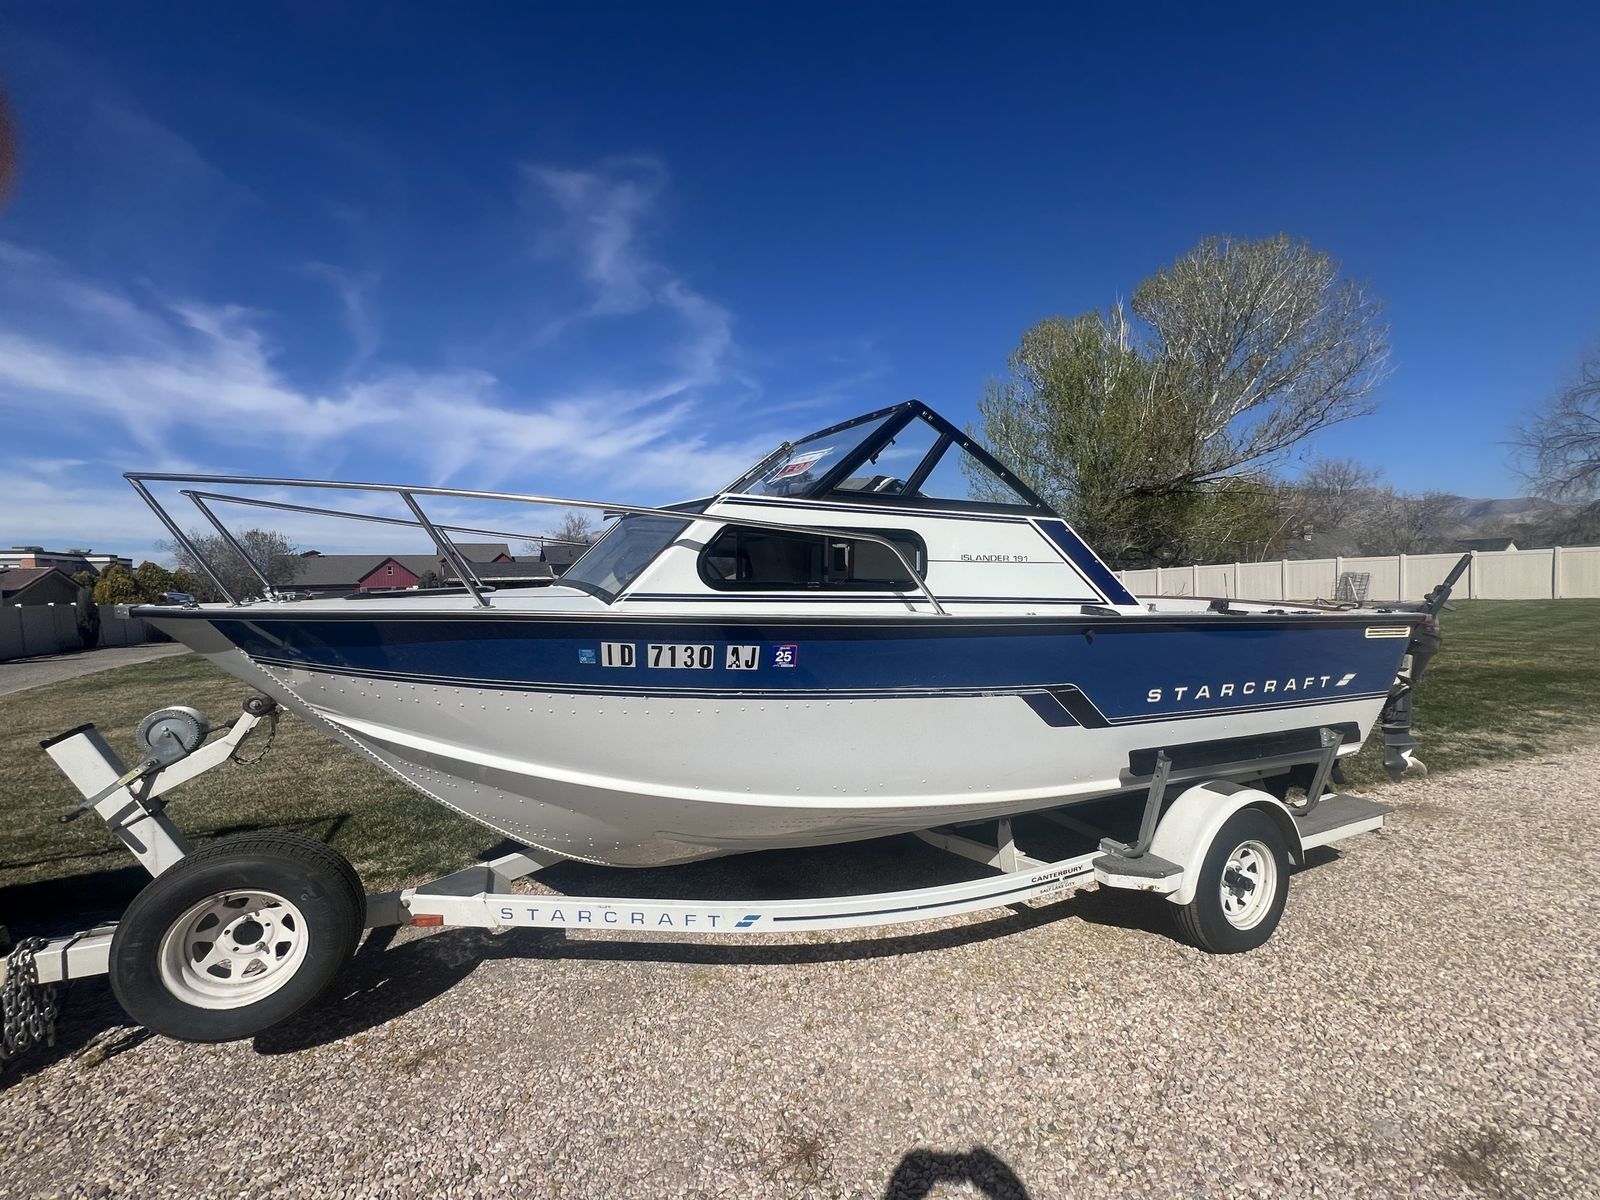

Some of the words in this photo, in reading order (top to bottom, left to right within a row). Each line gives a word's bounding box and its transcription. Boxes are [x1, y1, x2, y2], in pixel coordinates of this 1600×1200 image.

[960, 554, 1010, 562] ISLANDER
[607, 643, 633, 666] ID
[650, 645, 713, 668] 7130
[728, 646, 757, 669] AJ
[775, 651, 792, 662] 25
[1146, 676, 1330, 703] STARCRAFT
[1031, 865, 1083, 883] CANTERBURY
[1064, 881, 1076, 889] CITY
[500, 907, 721, 928] STARCRAFT
